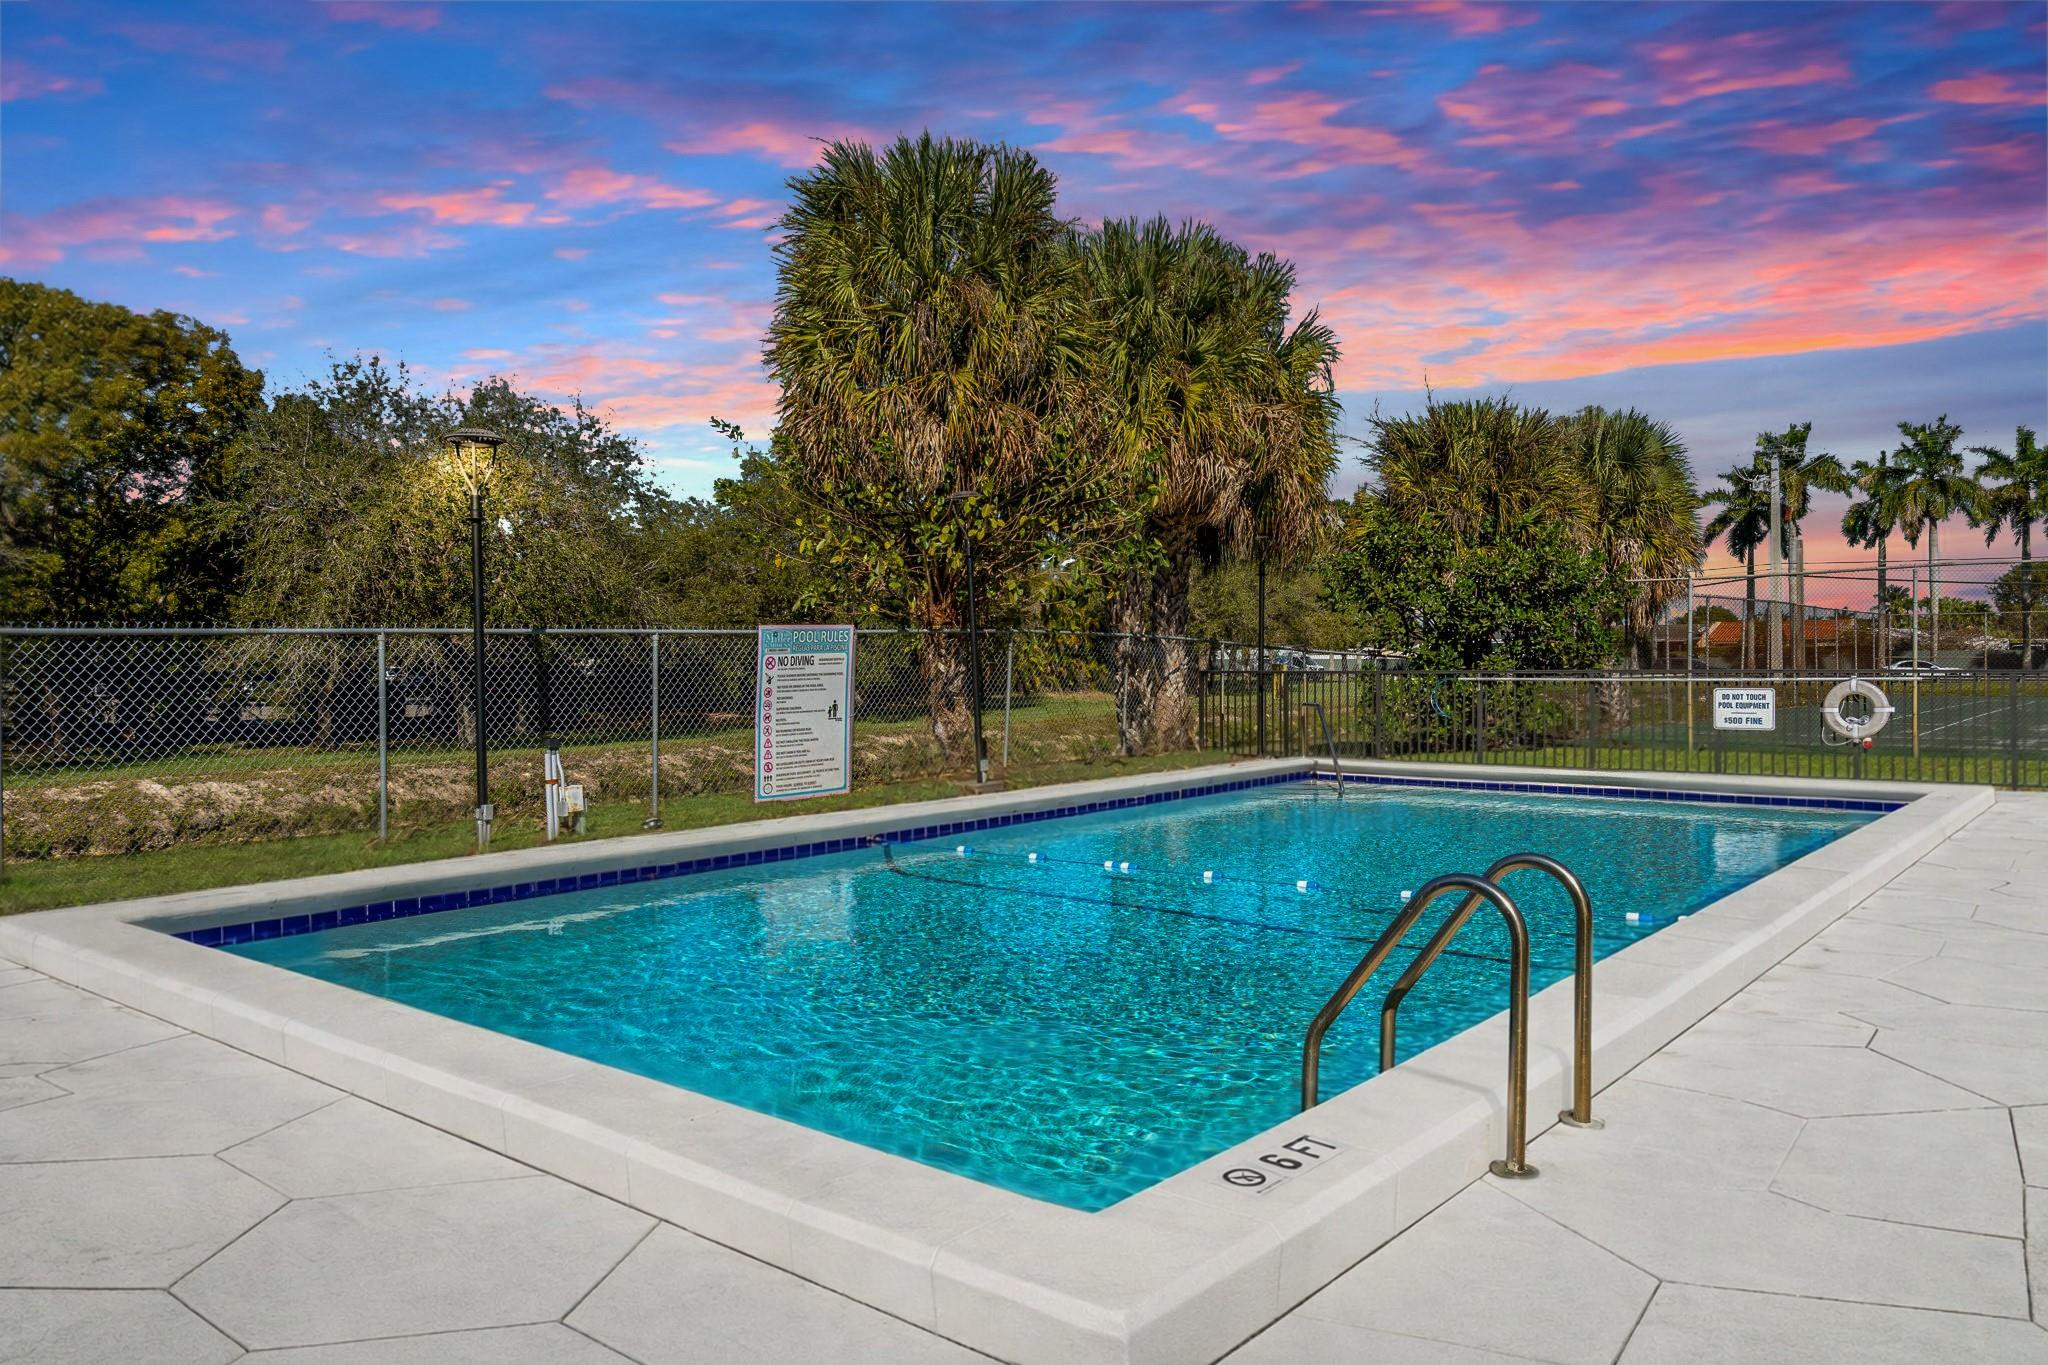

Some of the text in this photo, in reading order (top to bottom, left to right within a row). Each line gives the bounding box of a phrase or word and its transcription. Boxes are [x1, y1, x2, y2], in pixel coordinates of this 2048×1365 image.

[793, 630, 849, 643] POOL RULES
[777, 655, 815, 667] NO DIVING
[1745, 717, 1763, 725] FINE
[1259, 1135, 1337, 1170] 6 FT
